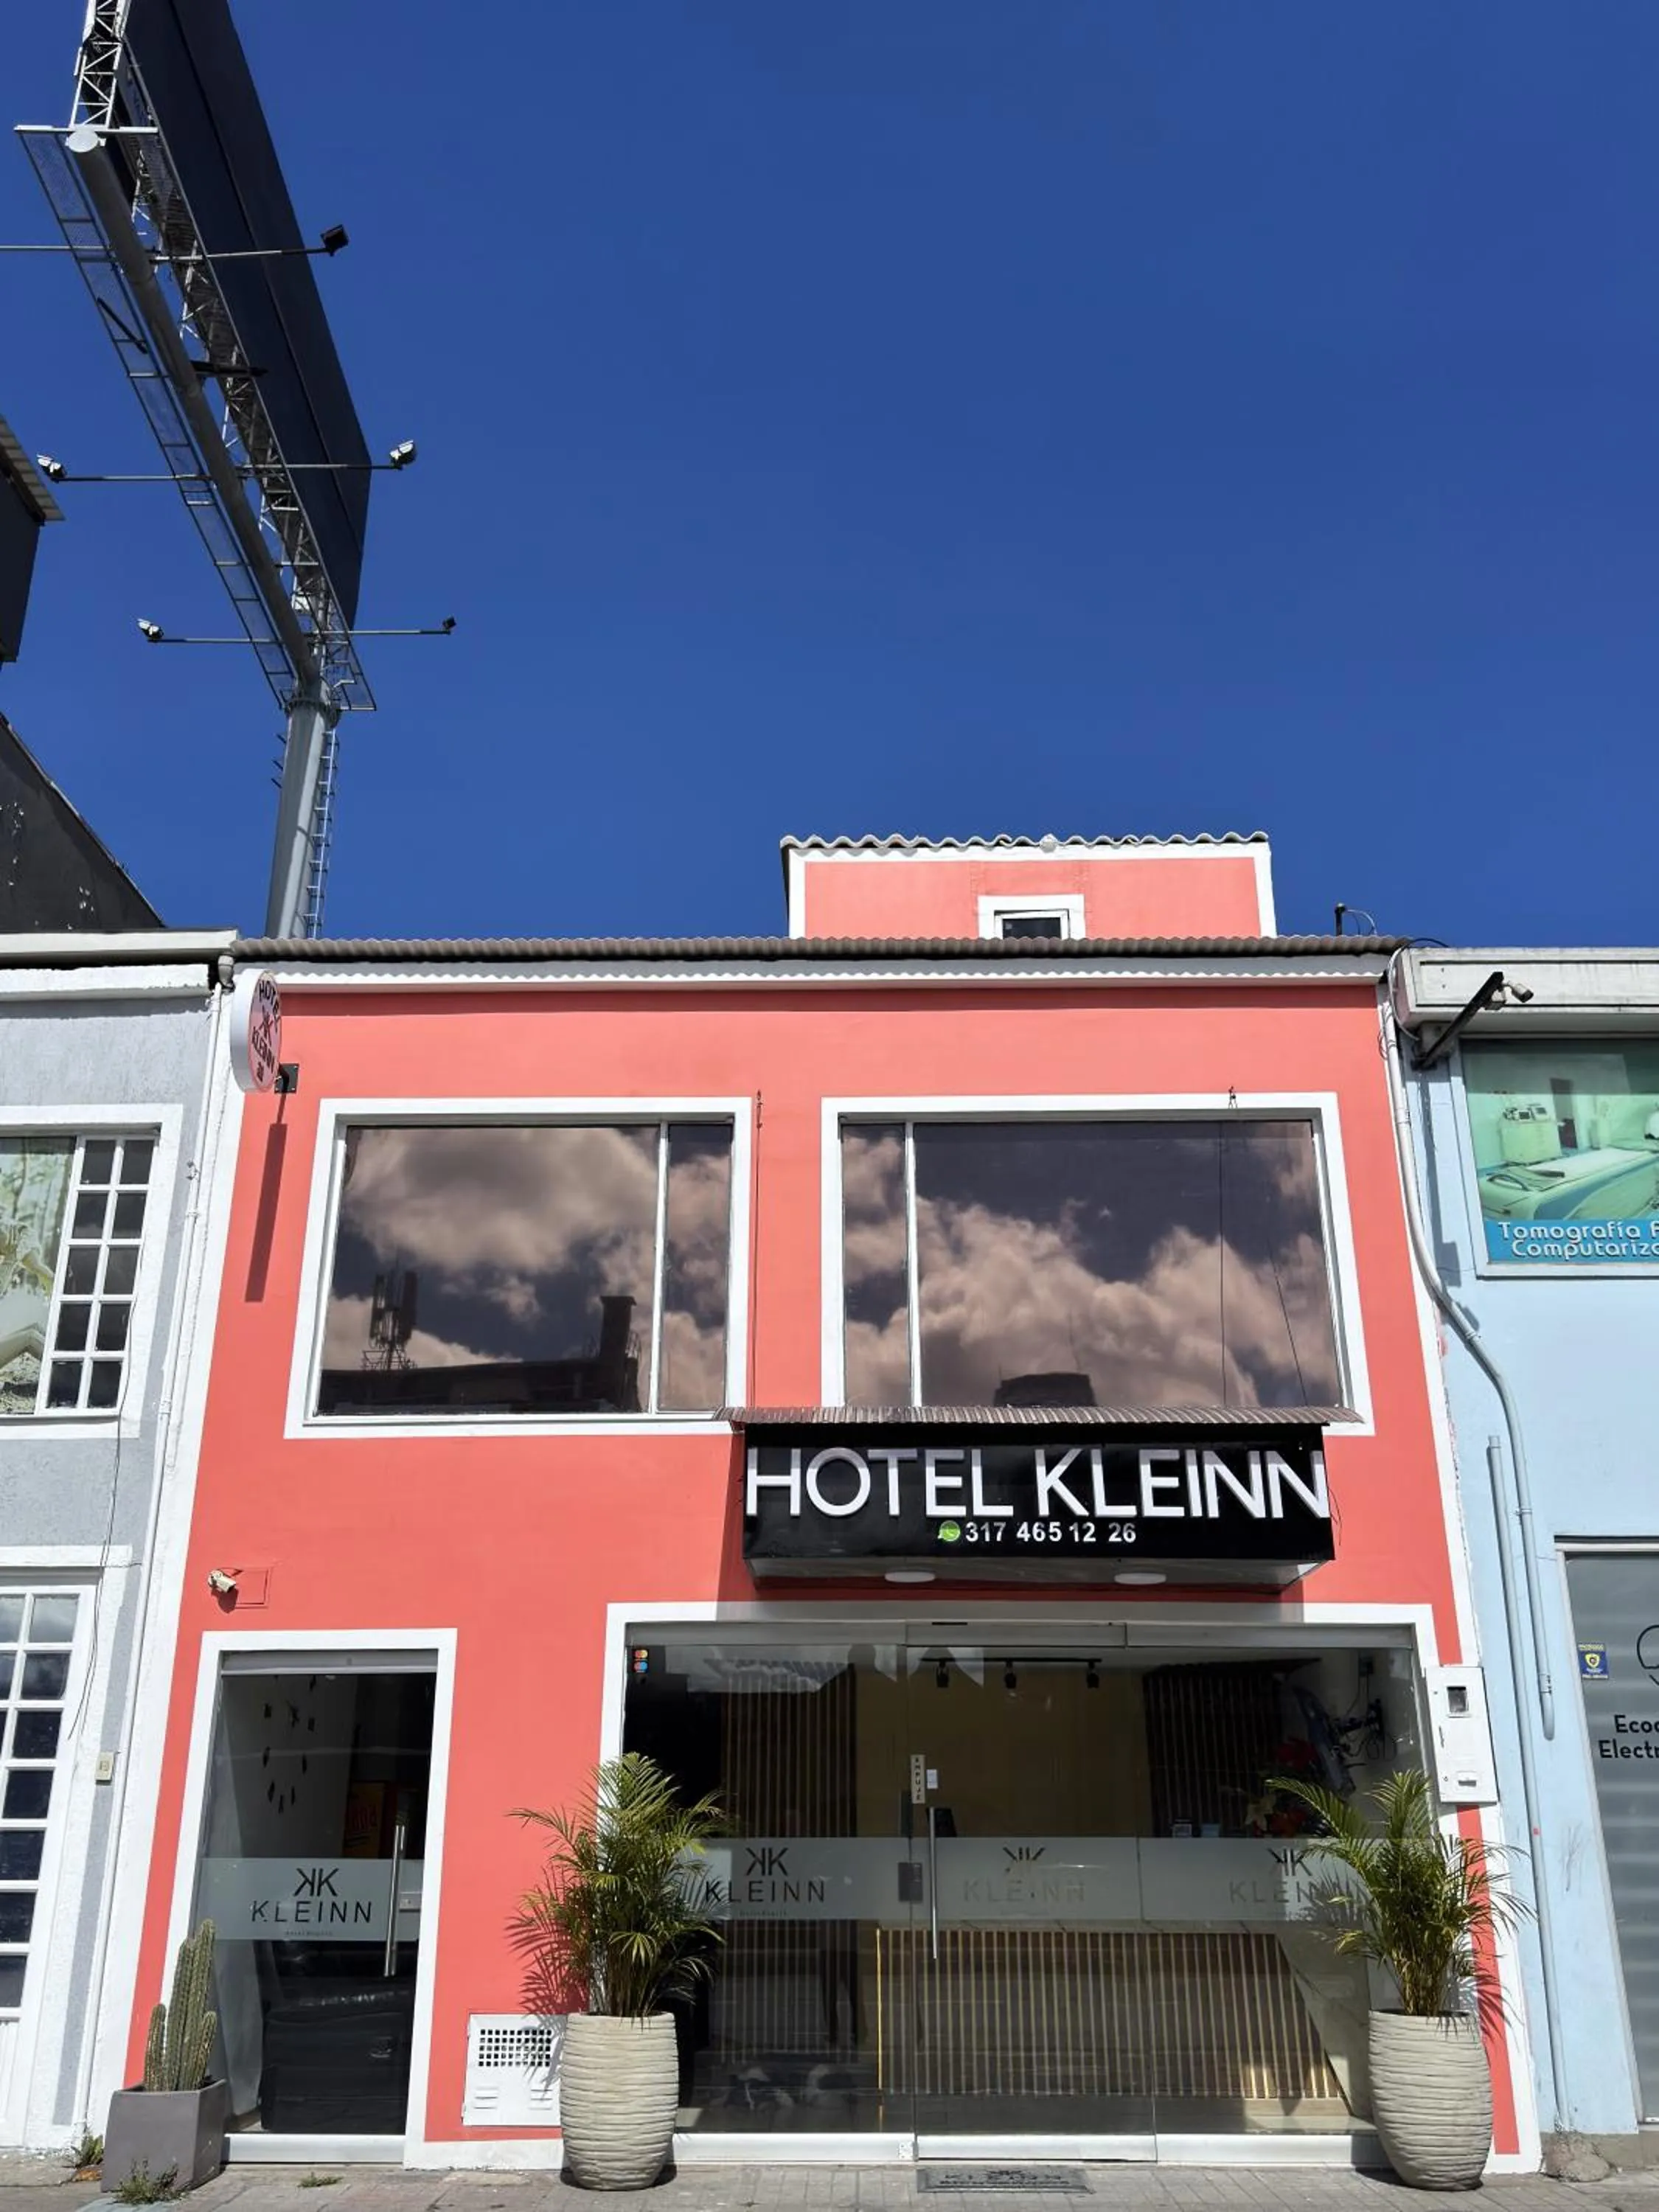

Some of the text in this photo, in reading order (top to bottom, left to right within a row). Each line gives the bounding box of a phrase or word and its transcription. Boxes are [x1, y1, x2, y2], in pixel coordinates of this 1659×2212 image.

[1498, 1221, 1641, 1244] Tomografía
[745, 1447, 1330, 1518] HOTEL KLEINN
[965, 1522, 1136, 1543] 317 465 12 26
[705, 1879, 825, 1903] KLEINN
[251, 1899, 372, 1924] KLEINN
